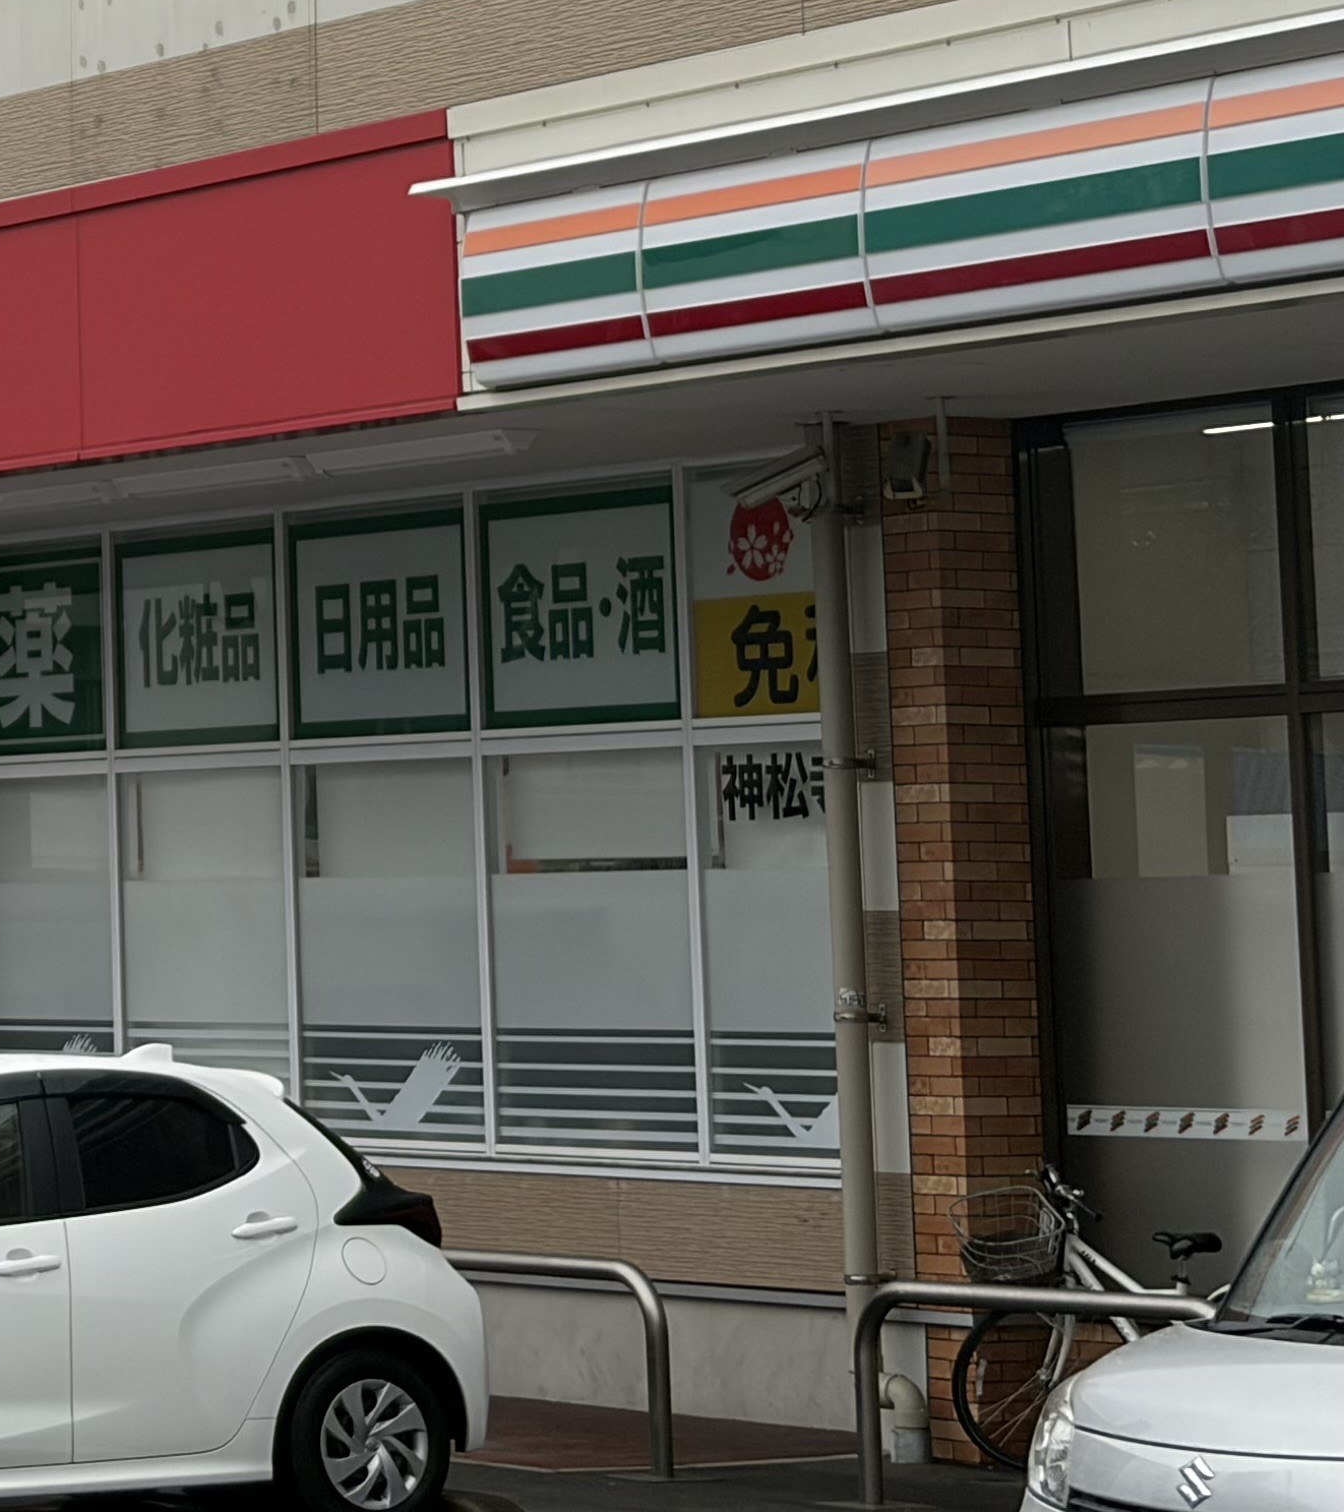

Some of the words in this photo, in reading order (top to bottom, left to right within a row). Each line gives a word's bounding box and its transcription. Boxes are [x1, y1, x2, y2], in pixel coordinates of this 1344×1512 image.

[137, 580, 262, 689] 化粧品
[315, 575, 447, 675] 日用品
